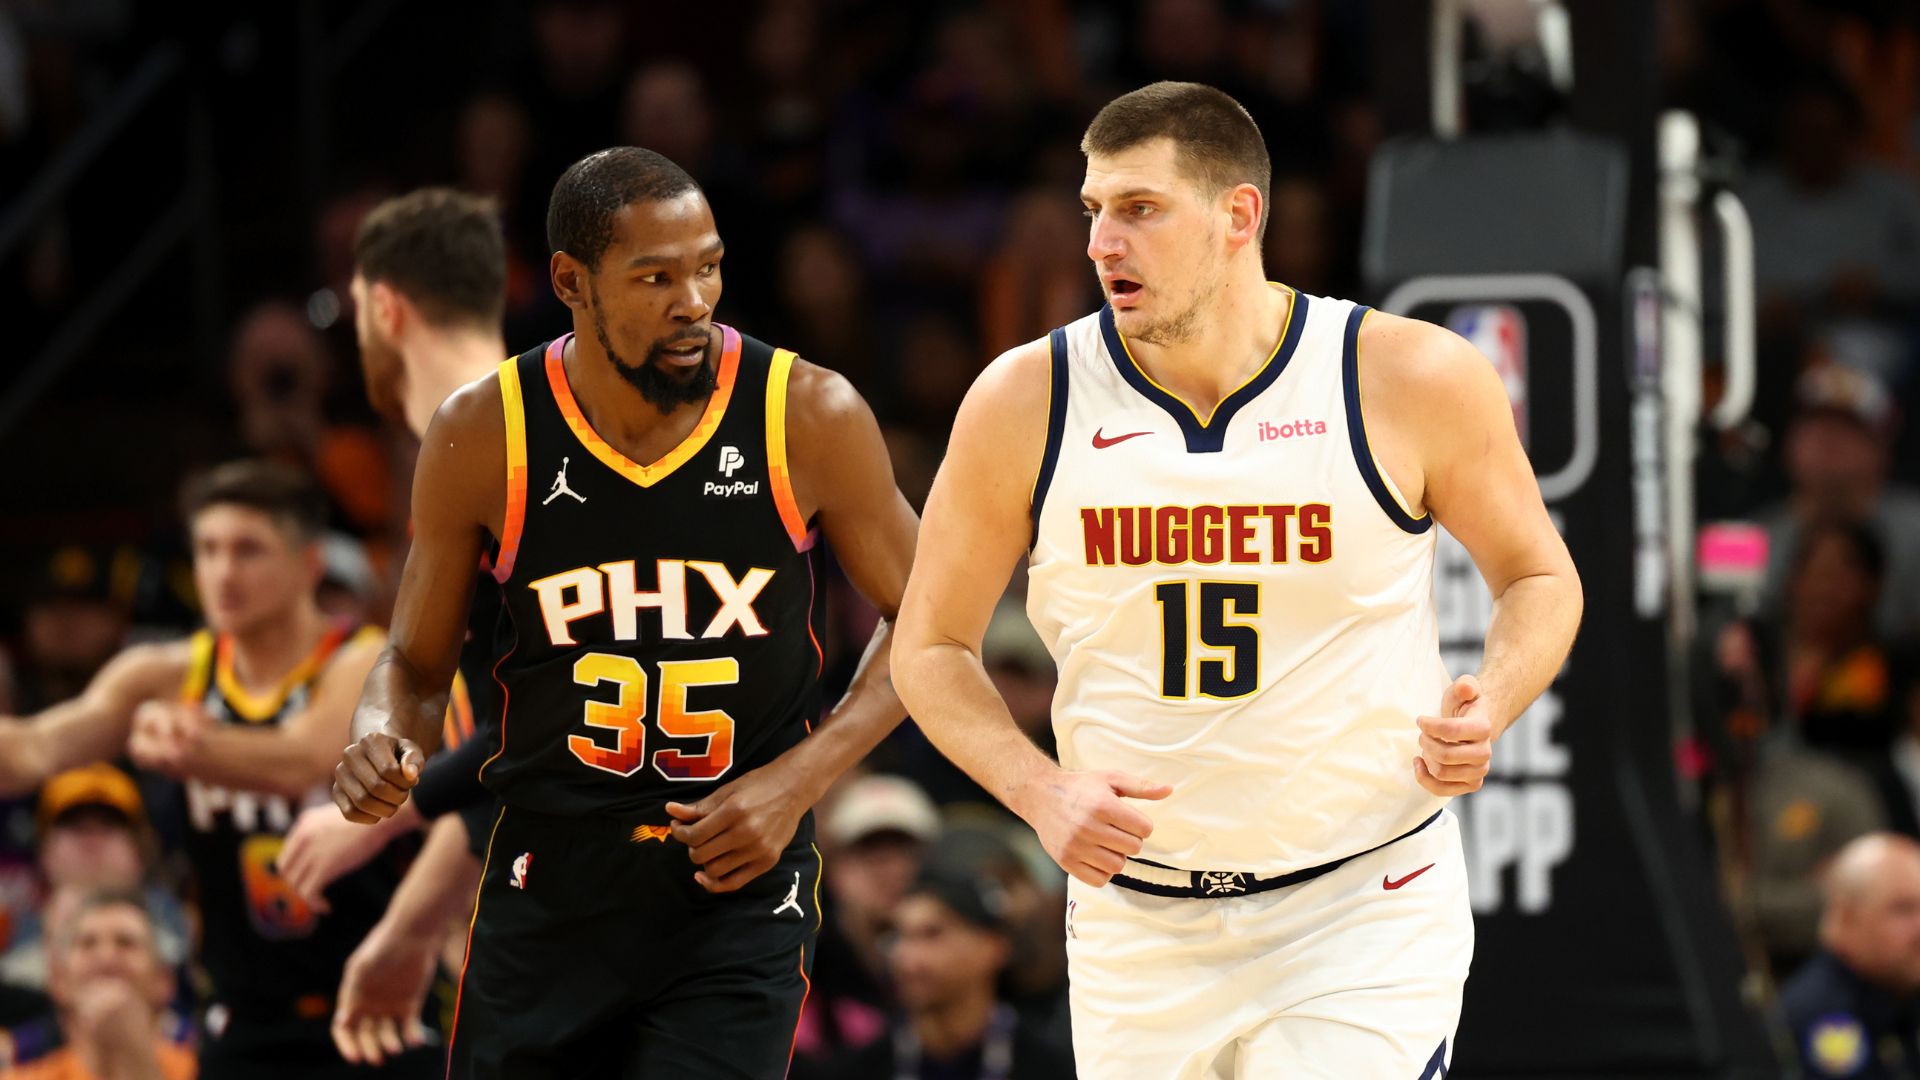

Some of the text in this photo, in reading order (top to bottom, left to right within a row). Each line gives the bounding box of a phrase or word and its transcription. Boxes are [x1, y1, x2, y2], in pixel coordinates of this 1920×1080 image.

[1258, 419, 1327, 442] ibotta
[703, 481, 759, 498] PayPal
[1080, 503, 1333, 567] NUGGETS
[528, 559, 776, 646] PHX
[1153, 579, 1262, 701] 15
[568, 652, 739, 781] 35
